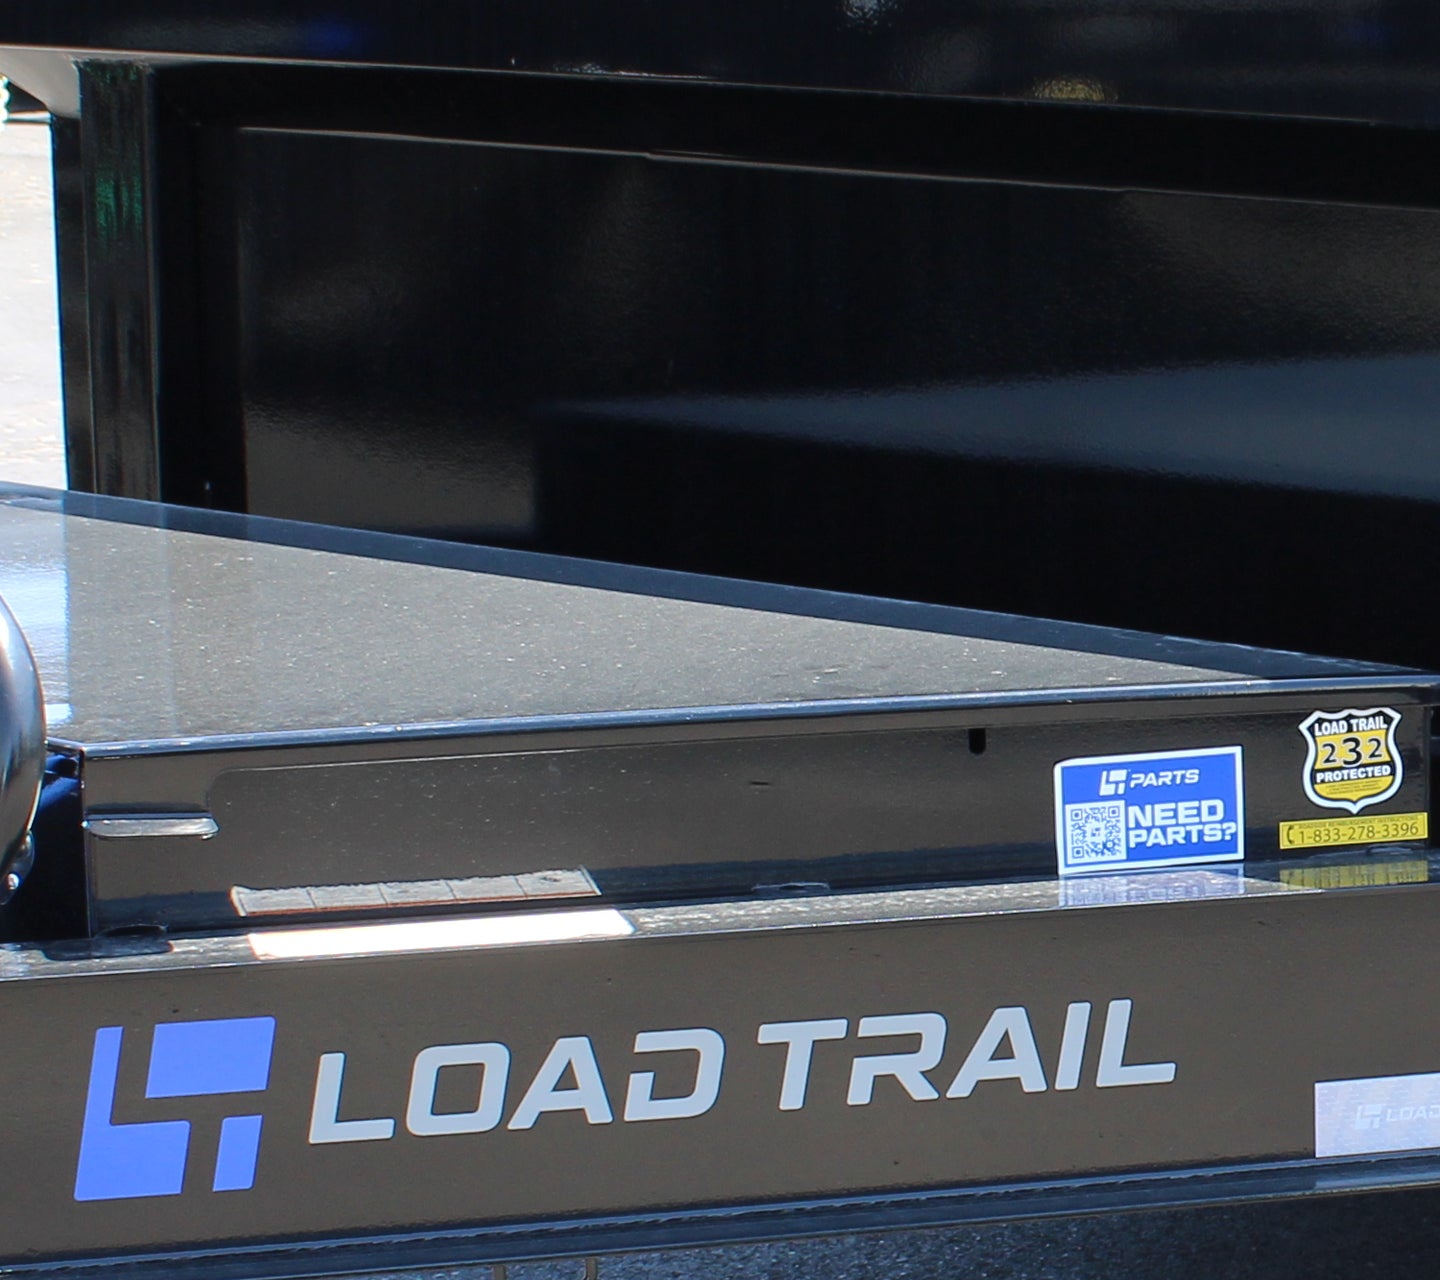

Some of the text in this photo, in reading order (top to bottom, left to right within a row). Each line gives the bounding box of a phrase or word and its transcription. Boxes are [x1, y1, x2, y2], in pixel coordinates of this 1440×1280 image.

[1314, 715, 1388, 736] LOAD TRAIL
[1129, 768, 1200, 789] PARTS
[1316, 765, 1391, 783] PROTECTED
[1128, 799, 1225, 828] NEED
[1128, 823, 1237, 849] PARTS?
[1298, 821, 1419, 844] 1-833-278-3396
[308, 1027, 726, 1145] LOAD
[757, 998, 1177, 1112] TRAIL
